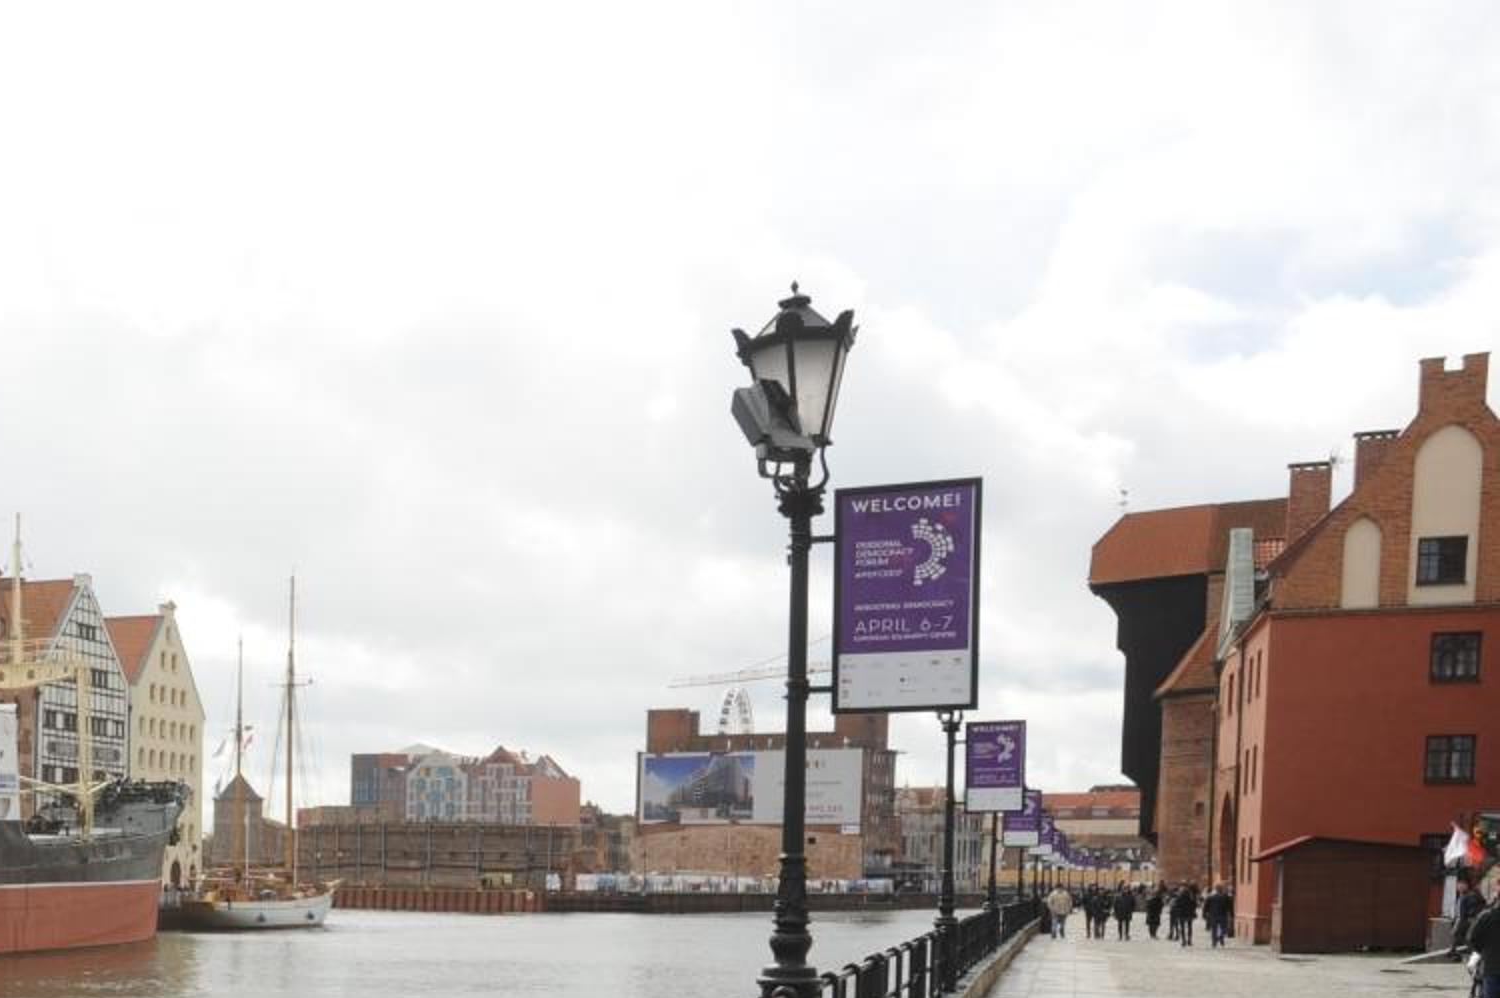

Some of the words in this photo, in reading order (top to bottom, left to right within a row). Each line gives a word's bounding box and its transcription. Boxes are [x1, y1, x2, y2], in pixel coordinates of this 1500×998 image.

[851, 492, 961, 513] WELCOME!
[855, 618, 911, 635] APRIL
[920, 615, 953, 632] 6-7
